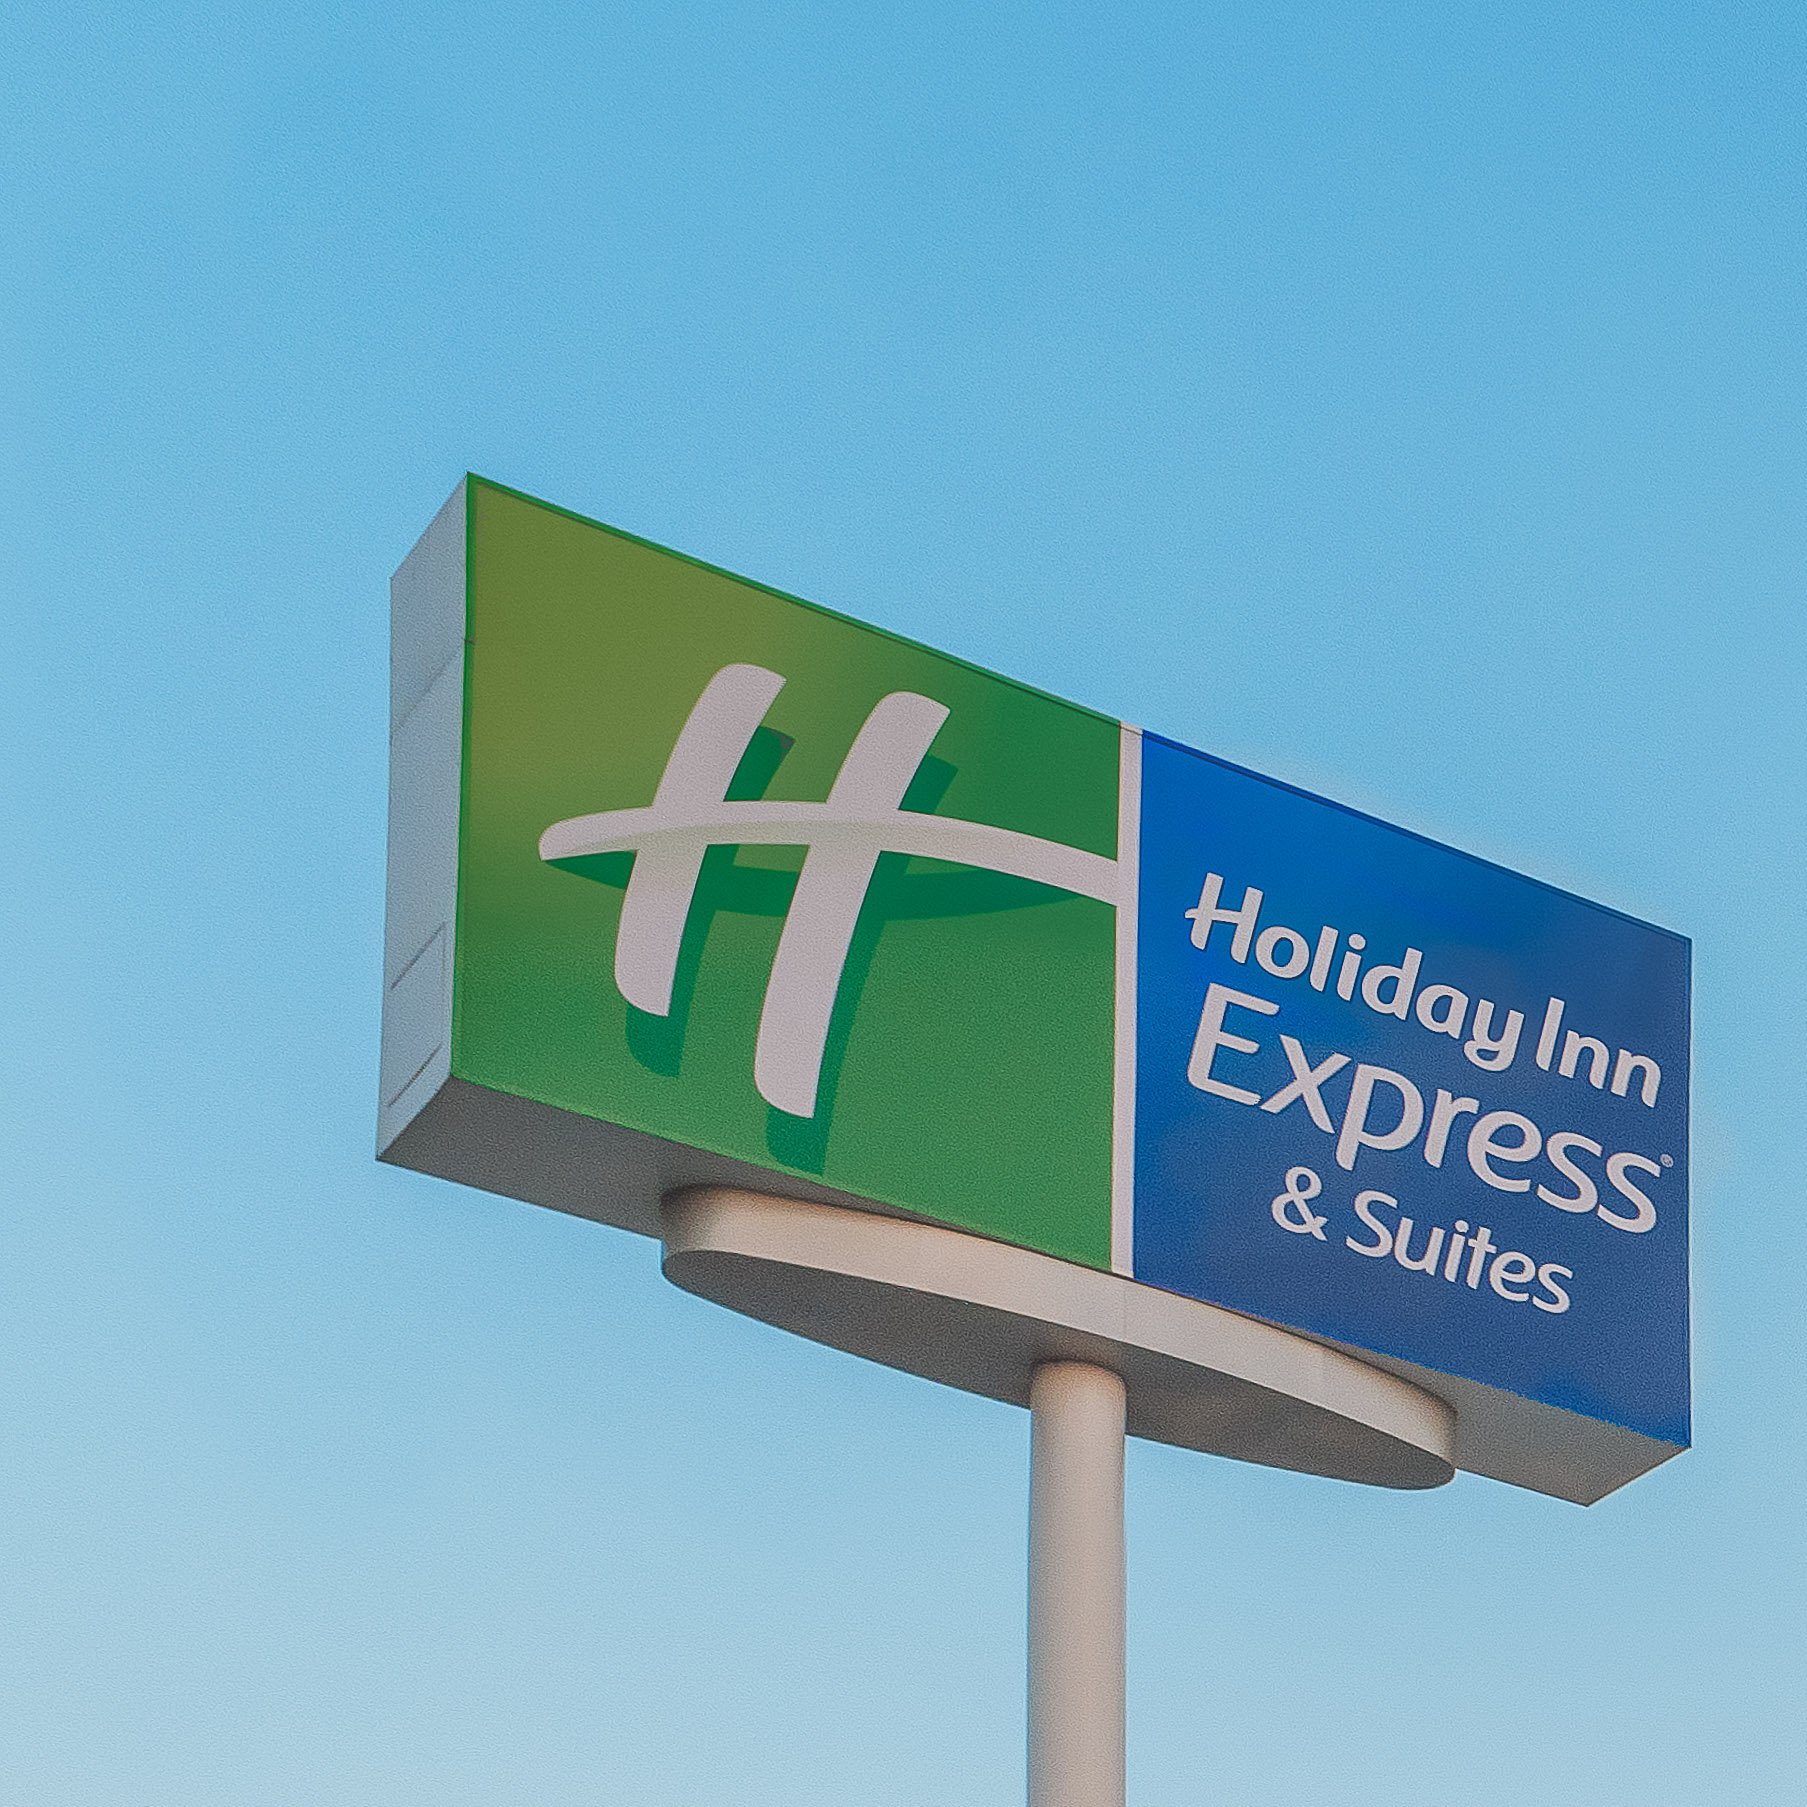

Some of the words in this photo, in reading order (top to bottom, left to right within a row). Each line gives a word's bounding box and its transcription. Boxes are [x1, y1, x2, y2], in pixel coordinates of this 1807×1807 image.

[1184, 872, 1525, 1072] Holiday
[1536, 997, 1662, 1108] Inn
[1186, 982, 1664, 1234] Express
[1271, 1166, 1327, 1241] &
[1346, 1189, 1573, 1314] Suites
